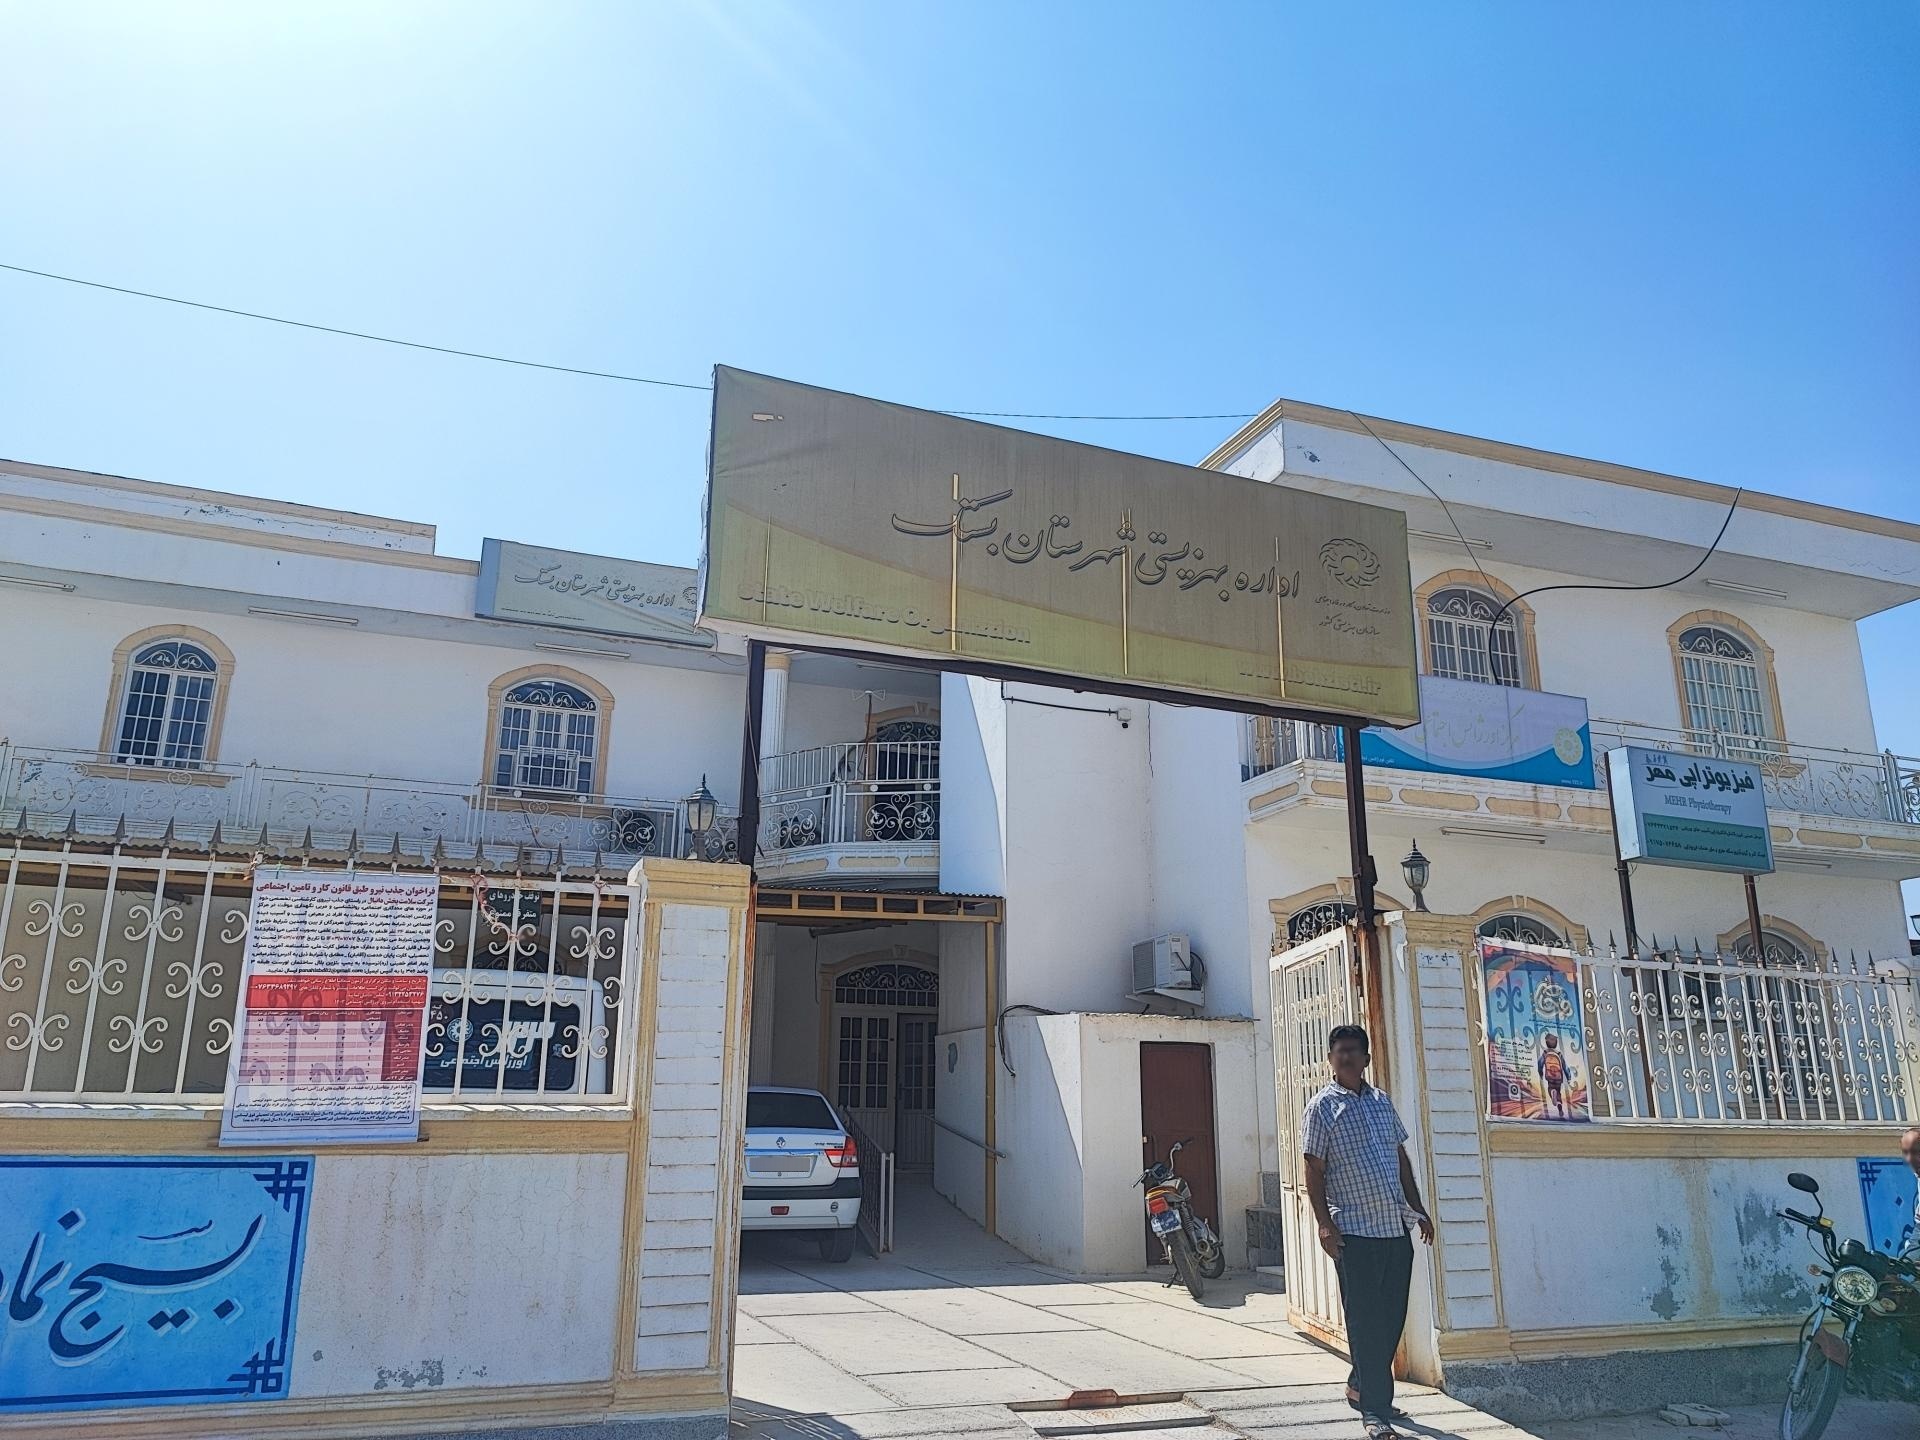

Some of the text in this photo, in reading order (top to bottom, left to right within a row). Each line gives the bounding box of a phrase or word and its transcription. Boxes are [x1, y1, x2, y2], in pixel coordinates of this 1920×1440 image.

[891, 488, 1300, 602] اداره بهزیستی شهرستان بستک
[1645, 761, 1755, 794] فیزیوتراپی مهر
[1664, 794, 1688, 808] MEHR
[256, 882, 436, 897] فراخوان جذب نیرو طبق قانون کار و تامین اجتماعی
[48, 1212, 267, 1367] بسیج
